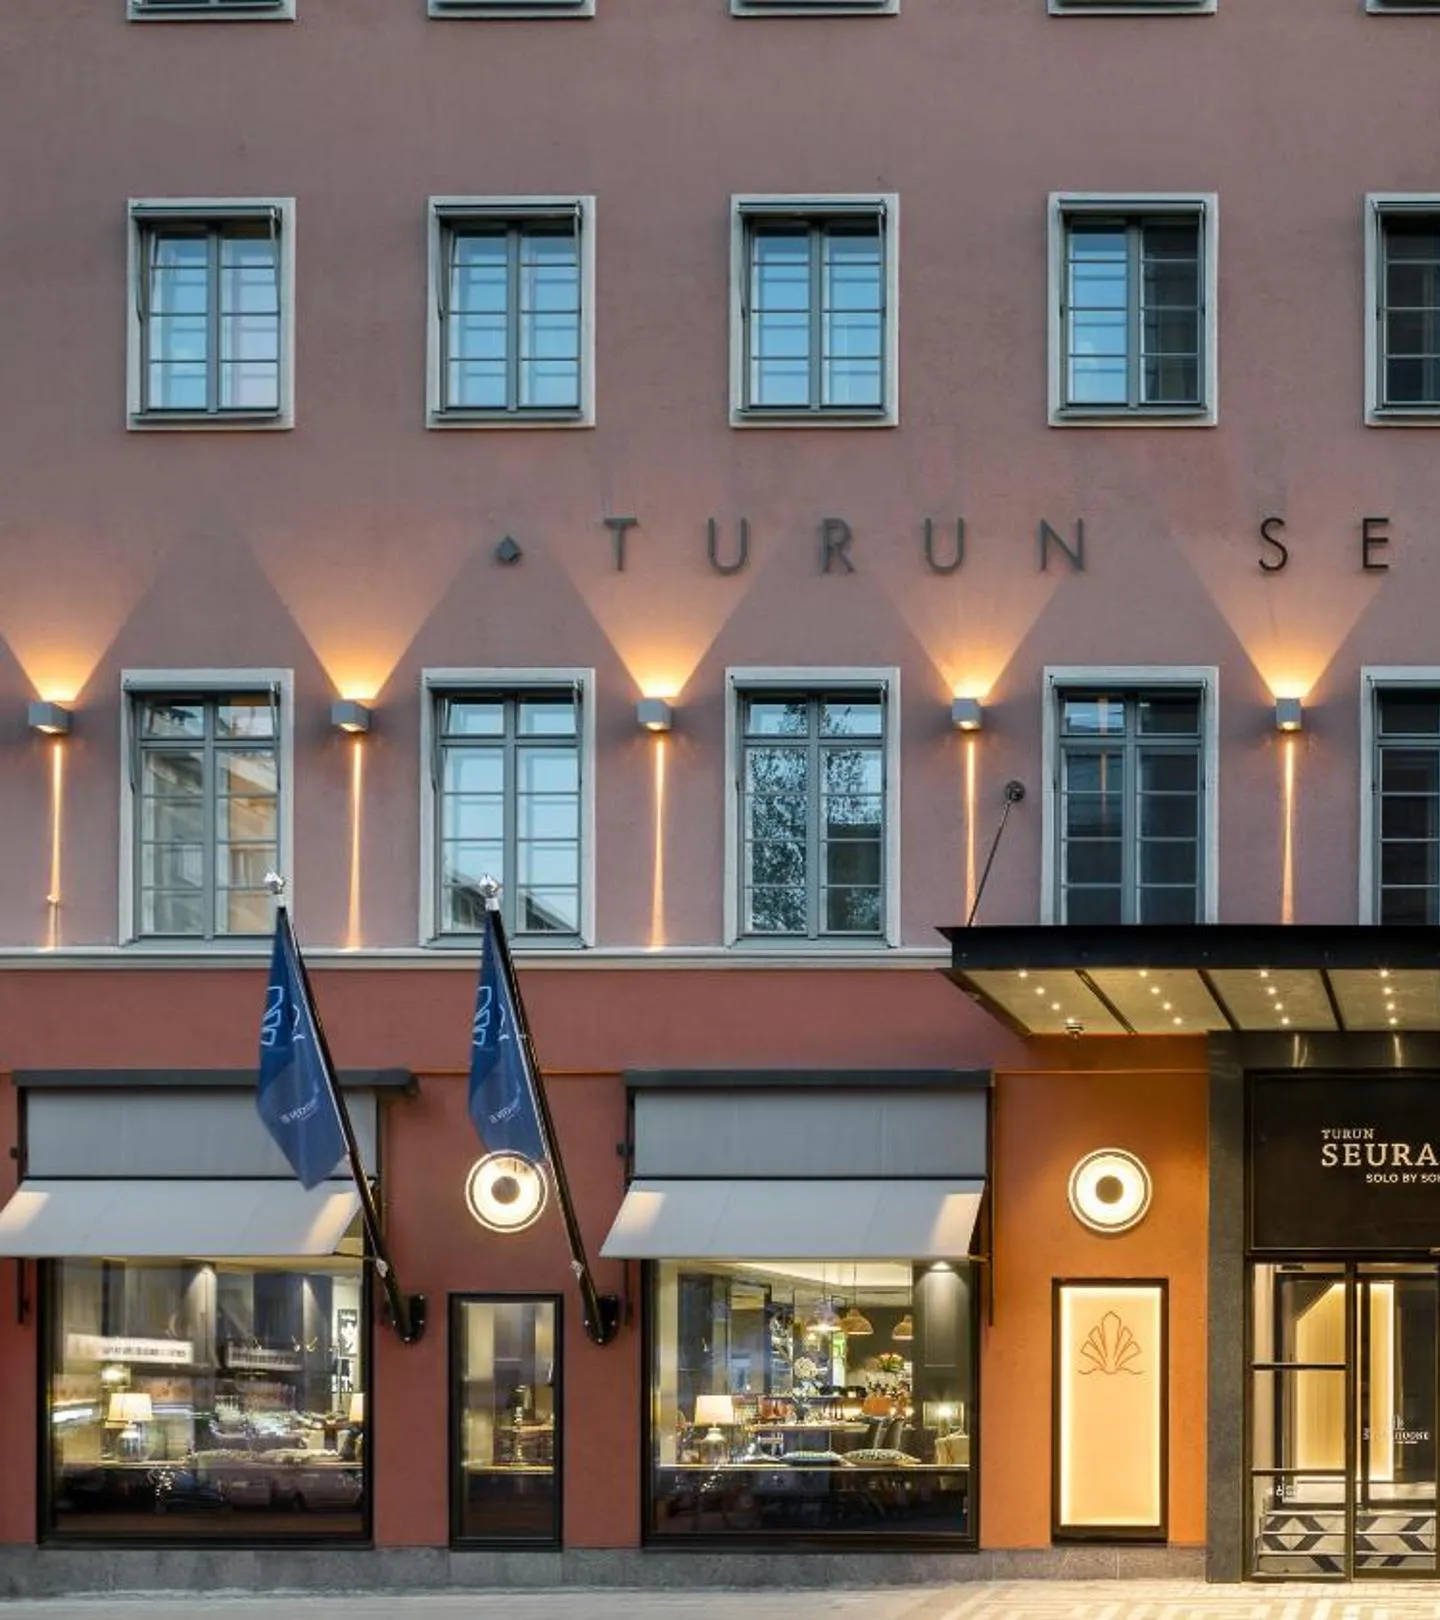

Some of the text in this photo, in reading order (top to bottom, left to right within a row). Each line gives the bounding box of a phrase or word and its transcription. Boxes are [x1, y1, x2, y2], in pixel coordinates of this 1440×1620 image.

[603, 517, 1086, 576] TURUN
[1321, 1128, 1375, 1140] TURUN
[1365, 1172, 1399, 1184] SOLO
[1402, 1172, 1418, 1184] BY
